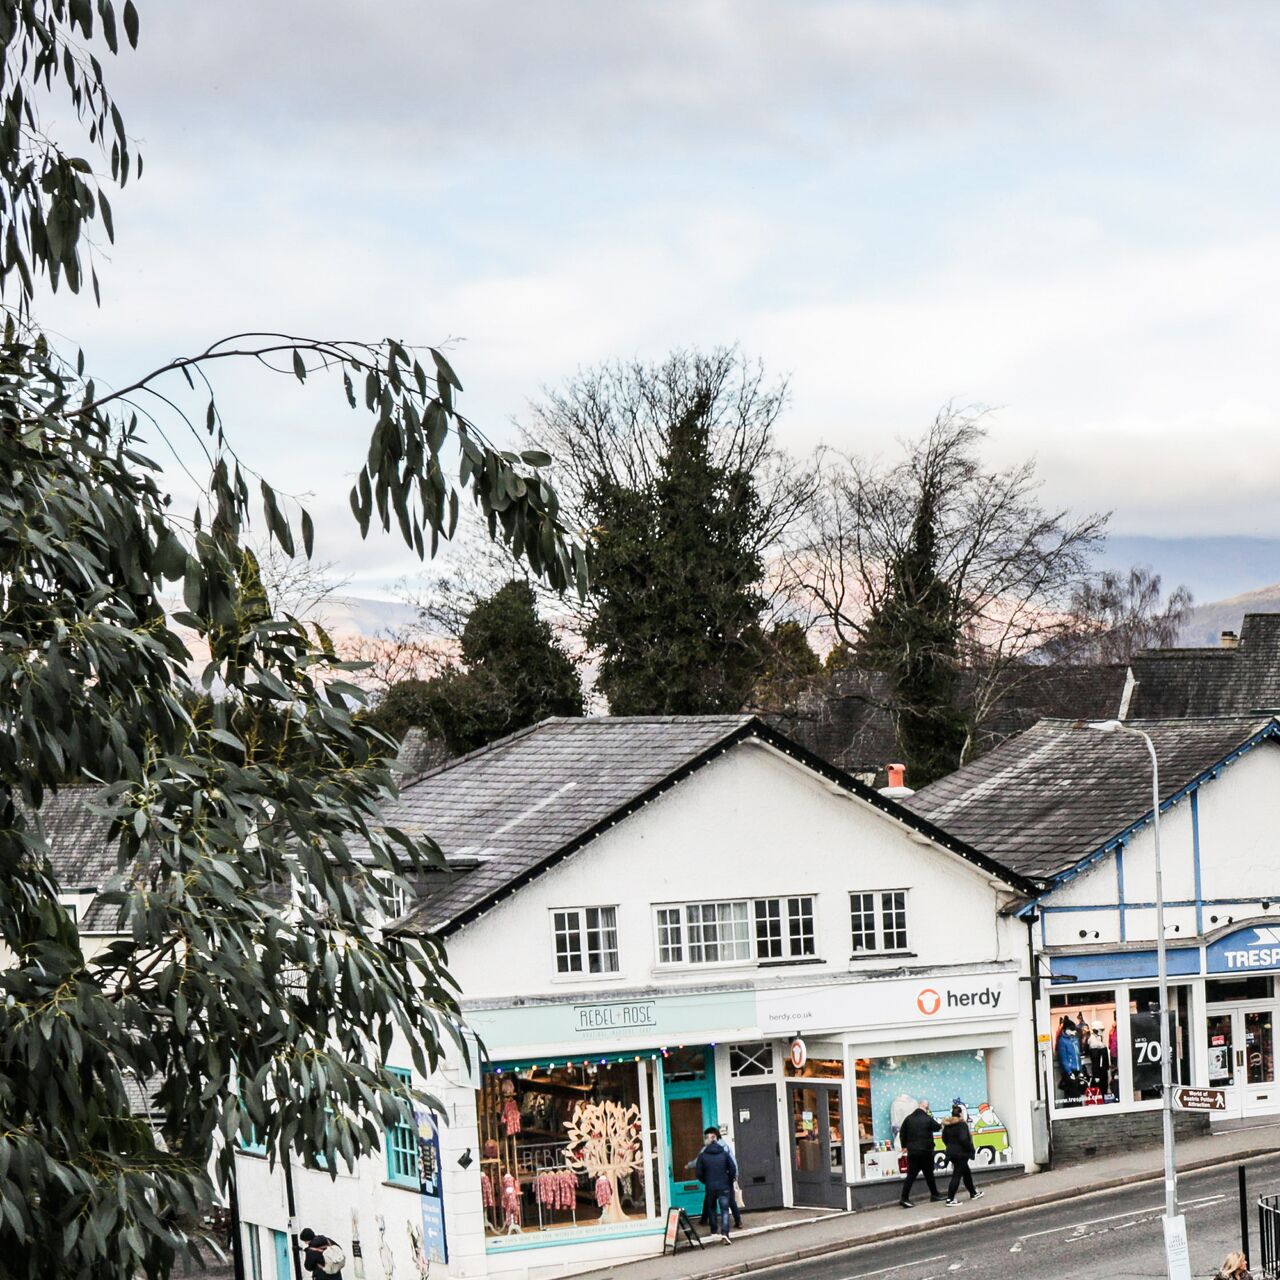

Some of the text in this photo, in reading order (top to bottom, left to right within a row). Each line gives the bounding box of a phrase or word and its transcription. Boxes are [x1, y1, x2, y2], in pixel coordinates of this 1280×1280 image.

[947, 988, 1001, 1008] herdy
[580, 1008, 616, 1027] REBEL
[623, 1006, 652, 1024] ROSE
[769, 1012, 813, 1022] herdy.co.uk
